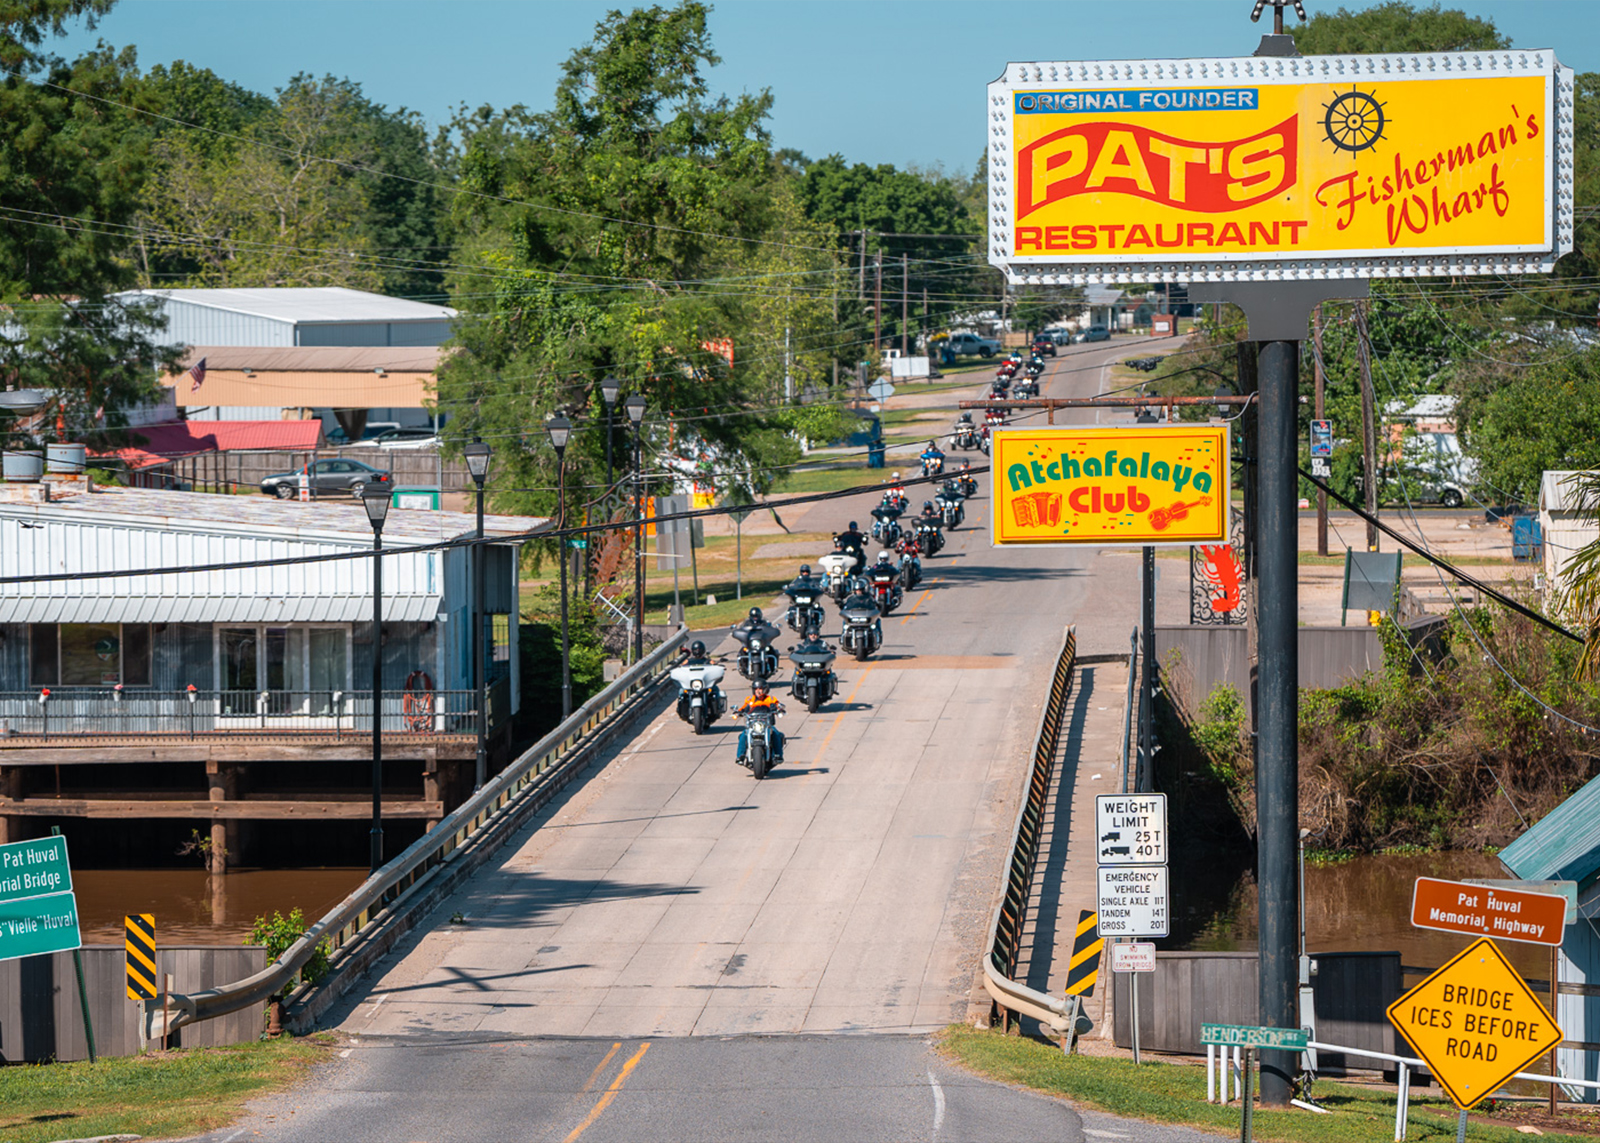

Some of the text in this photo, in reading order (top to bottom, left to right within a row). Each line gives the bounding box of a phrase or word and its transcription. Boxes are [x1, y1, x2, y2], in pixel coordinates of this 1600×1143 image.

[1019, 91, 1255, 111] ORIGINAL FOUNDER
[1031, 130, 1286, 206] PAT'S
[1315, 104, 1539, 231] Fisherman's
[1387, 162, 1510, 246] Wharf
[1015, 220, 1308, 250] RESTAURANT
[1007, 450, 1213, 494] Atchafalaya
[1068, 485, 1151, 514] Club
[1104, 802, 1157, 813] WEIGHT
[1112, 816, 1149, 828] LIMIT
[3, 845, 59, 868] Pat Huval
[0, 871, 61, 893] rial Bridge
[1105, 873, 1159, 881] EMERGENCY
[1114, 885, 1151, 893] VEHICLE
[1101, 897, 1127, 906] SINGLE
[1129, 897, 1149, 906] AXLE
[1457, 893, 1522, 913] Pat Huval
[1101, 908, 1165, 918] TANDEM 14T
[1429, 907, 1545, 938] Memorial Highway
[1101, 920, 1165, 930] GROSS 20T
[1443, 984, 1514, 1012] BRIDGE
[1411, 1006, 1540, 1042] ICES BEFORE
[1201, 1026, 1281, 1046] HENDERSON
[1446, 1038, 1498, 1062] ROAD
